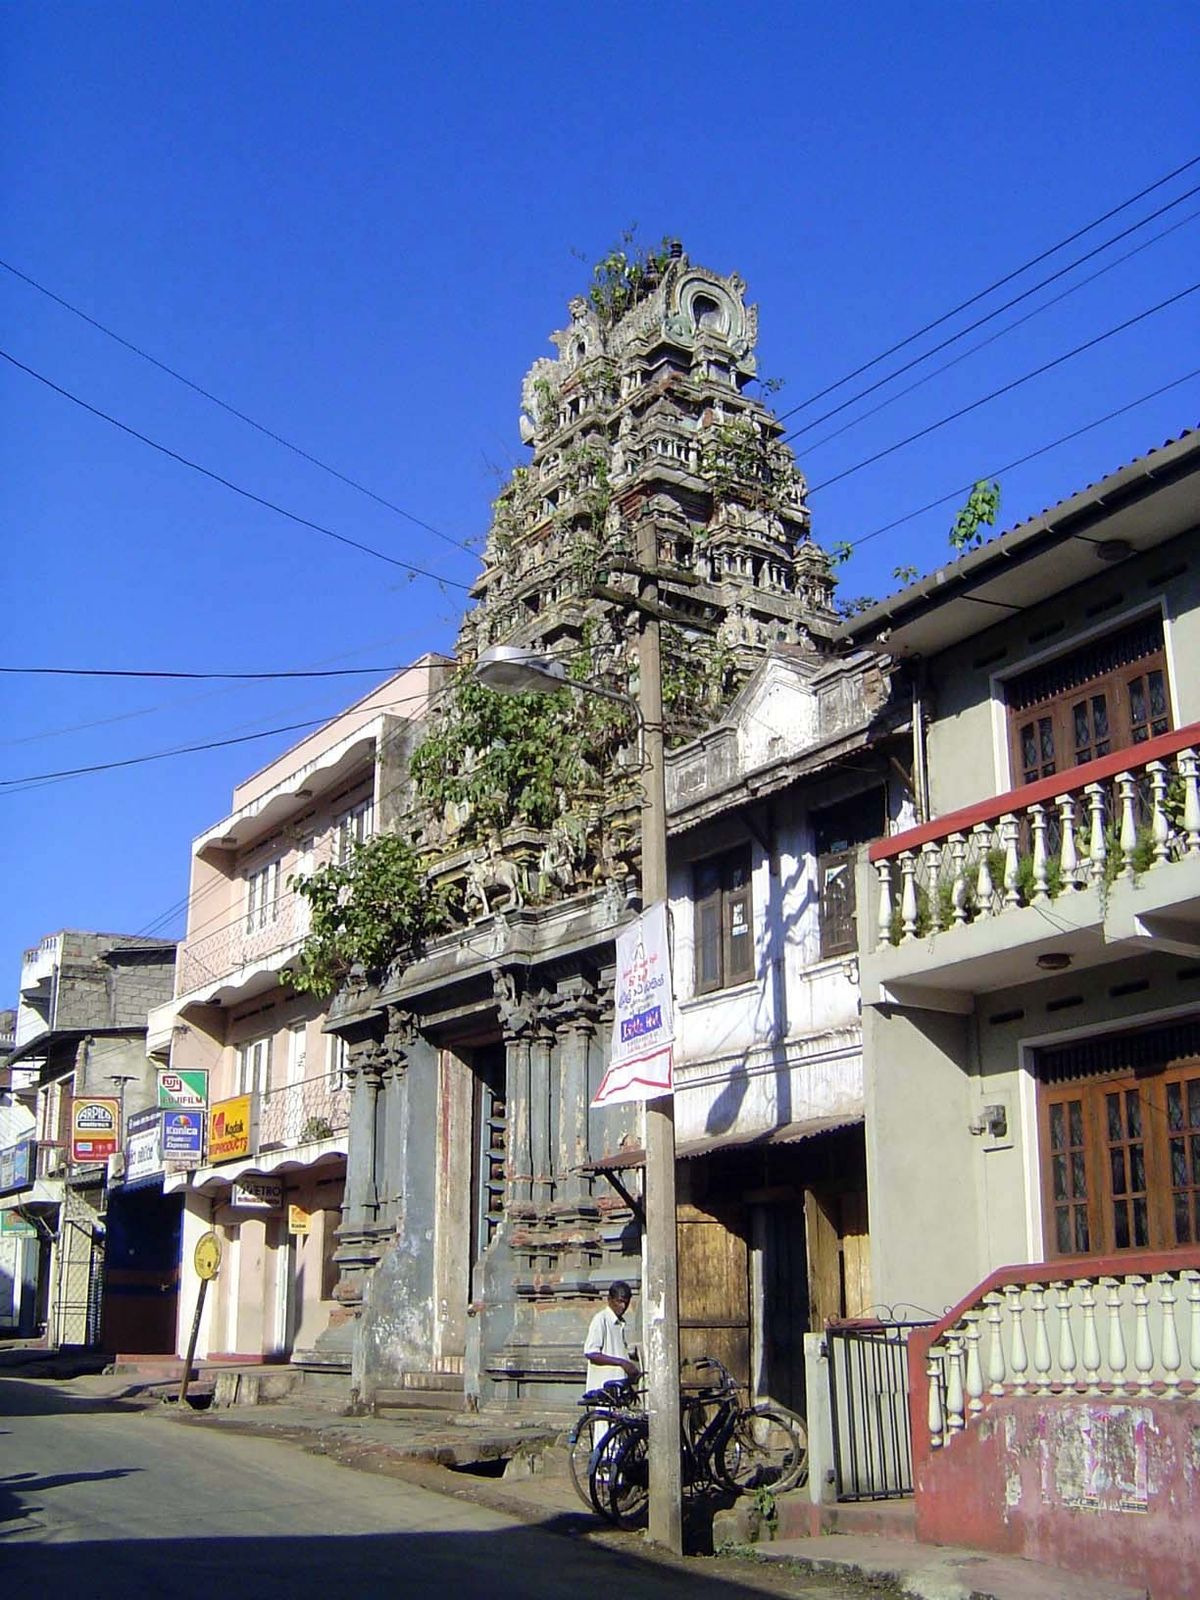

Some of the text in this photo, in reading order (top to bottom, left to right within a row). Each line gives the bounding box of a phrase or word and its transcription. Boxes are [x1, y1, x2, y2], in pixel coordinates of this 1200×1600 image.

[161, 1095, 203, 1104] FUJIFILM
[166, 1125, 198, 1135] Konica
[225, 1119, 244, 1135] Kodak
